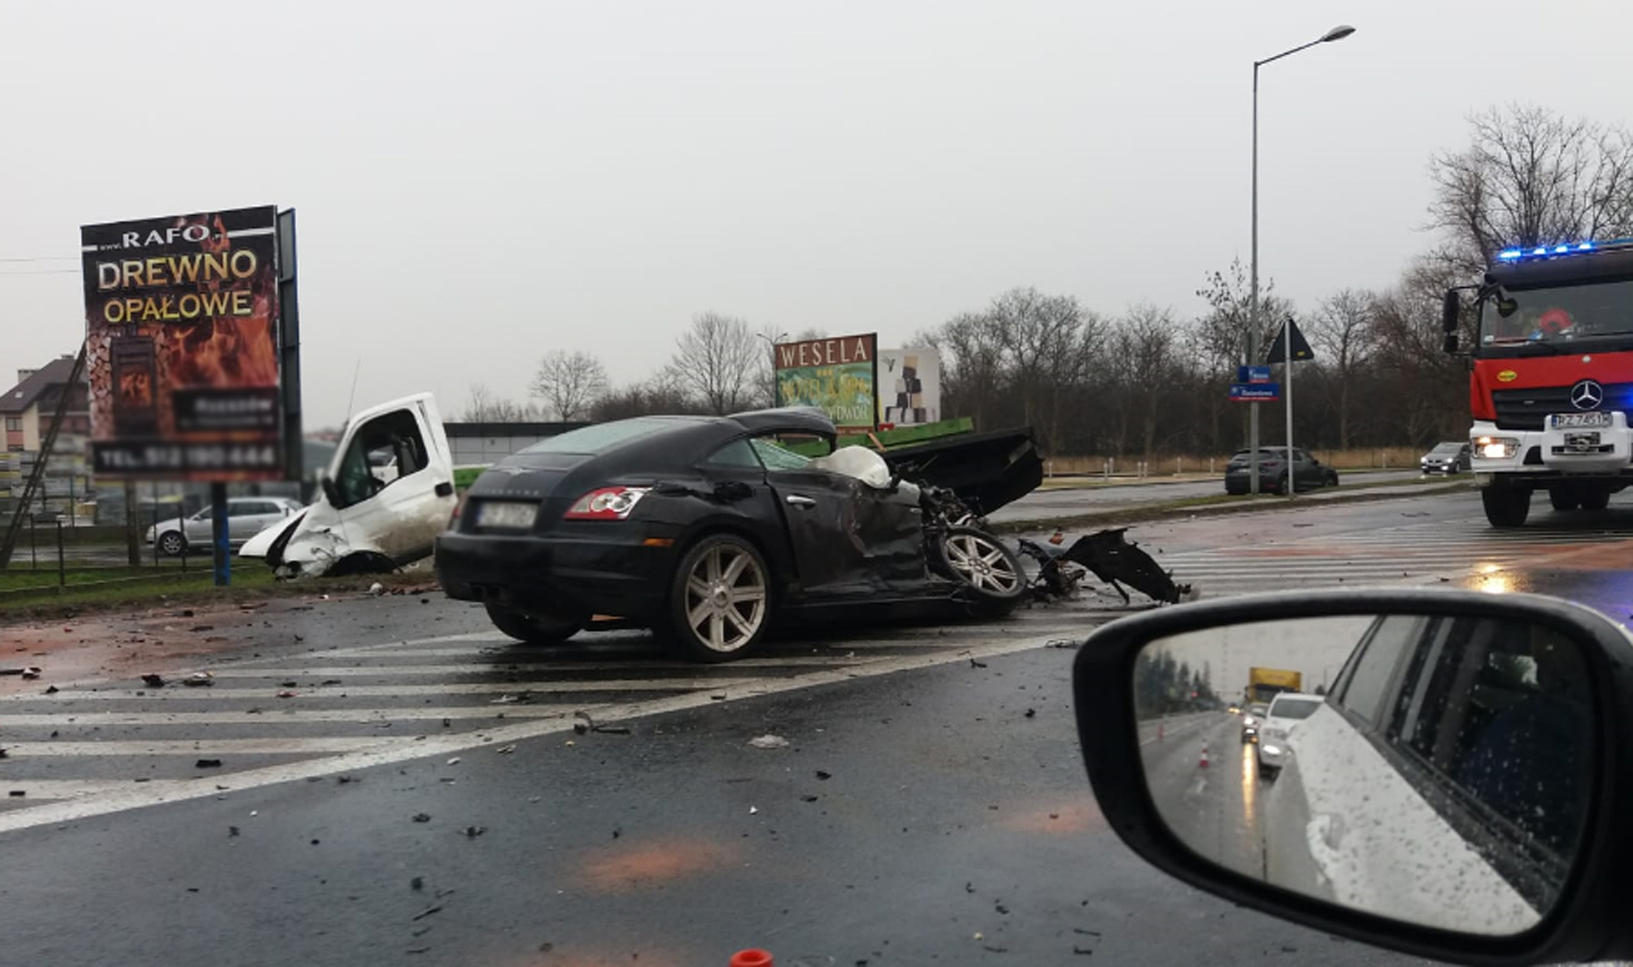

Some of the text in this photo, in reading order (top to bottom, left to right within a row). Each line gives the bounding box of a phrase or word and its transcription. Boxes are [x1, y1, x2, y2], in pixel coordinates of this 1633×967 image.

[98, 249, 257, 290] DREWNO
[103, 290, 252, 323] OPAŁOWE
[780, 337, 867, 367] WESELA
